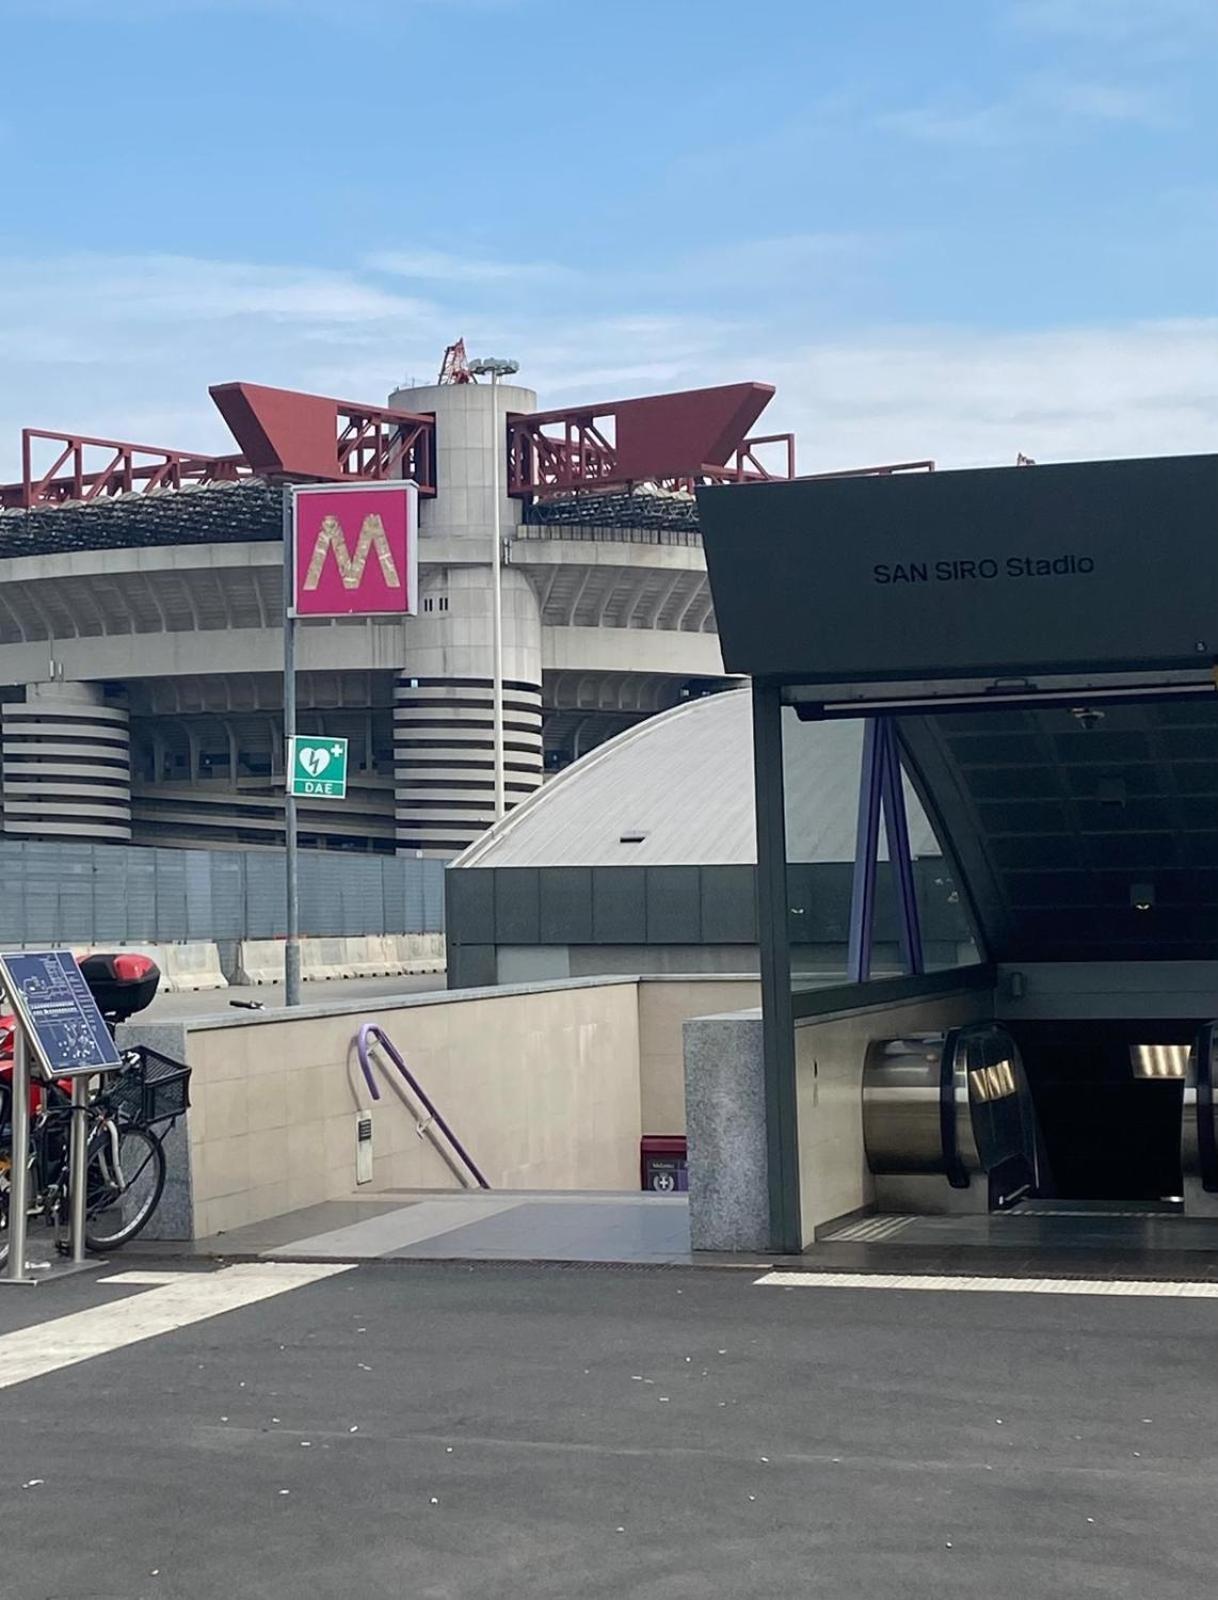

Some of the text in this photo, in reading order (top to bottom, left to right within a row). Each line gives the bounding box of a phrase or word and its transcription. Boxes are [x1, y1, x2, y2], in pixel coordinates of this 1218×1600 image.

[302, 513, 400, 591] M
[873, 555, 1094, 584] SAN SIRO Stadio
[304, 782, 333, 795] DAE
